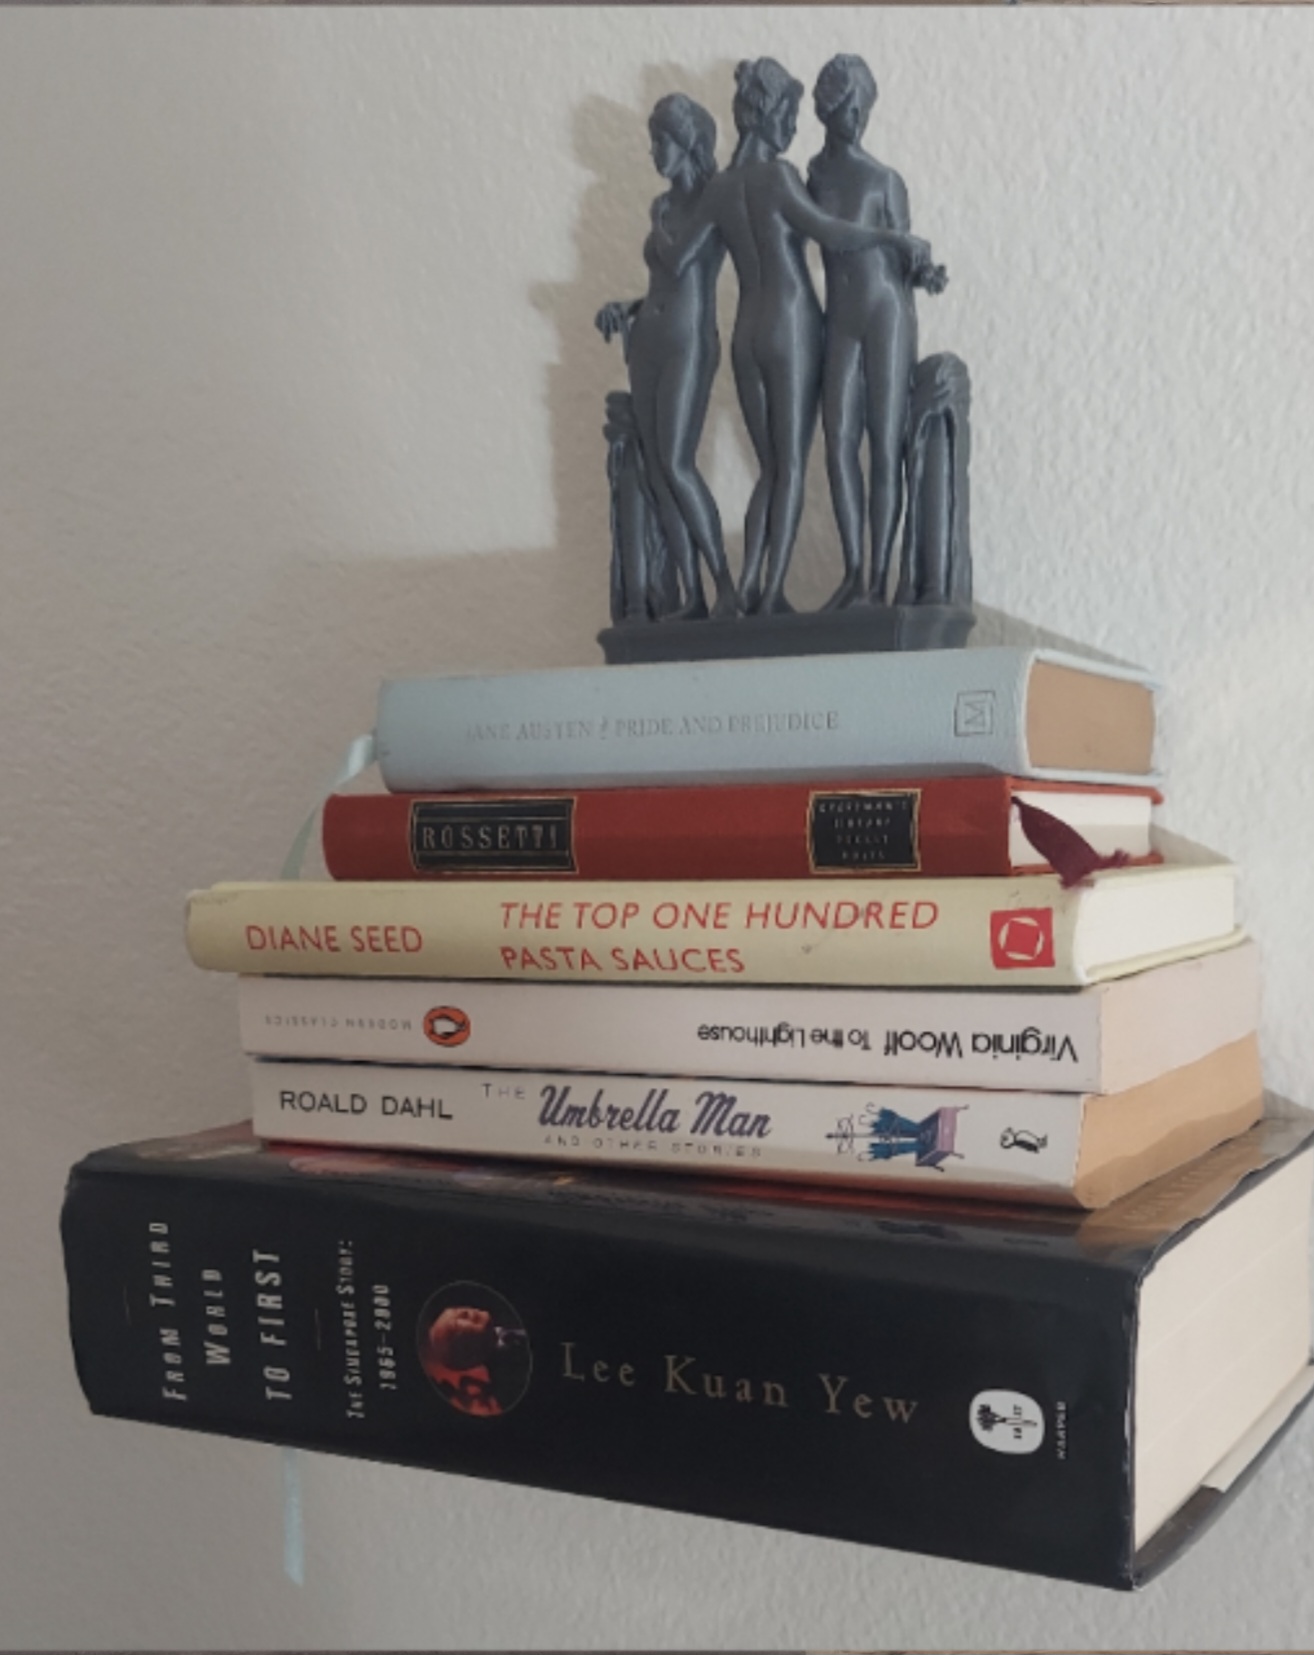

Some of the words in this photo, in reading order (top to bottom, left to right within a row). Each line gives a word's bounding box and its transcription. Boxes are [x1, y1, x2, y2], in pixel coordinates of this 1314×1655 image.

[515, 721, 592, 741] AUSTEN
[615, 717, 674, 738] PRIDE
[679, 715, 722, 736] AND
[727, 710, 840, 734] PREJUDICE
[422, 824, 558, 849] ROSSETTI
[500, 902, 563, 930] THE
[575, 902, 641, 930] TOP
[652, 902, 732, 930] ONE
[744, 901, 940, 930] HUNDRED
[246, 925, 342, 952] DIANE
[351, 926, 424, 953] SEED
[500, 946, 603, 971] PASTA
[610, 947, 746, 973] SAUCES
[697, 1021, 806, 1049] Lighthouse
[809, 1026, 845, 1049] the
[848, 1028, 871, 1051] To
[884, 1029, 963, 1059] Woolf
[971, 1026, 1079, 1064] Virginia
[278, 1091, 369, 1116] ROALD
[381, 1095, 453, 1119] DAHL
[480, 1083, 526, 1100] THE
[537, 1083, 682, 1135] Umbrella
[689, 1090, 772, 1139] Man
[671, 1141, 763, 1158] STORIES
[148, 1221, 175, 1308] THIRD
[251, 1249, 288, 1347] FIRST
[200, 1268, 232, 1366] WORLD
[157, 1327, 189, 1401] FROM
[263, 1366, 293, 1401] TO
[559, 1342, 637, 1386] Lee
[663, 1355, 790, 1409] Kuan
[817, 1373, 919, 1425] Yew
